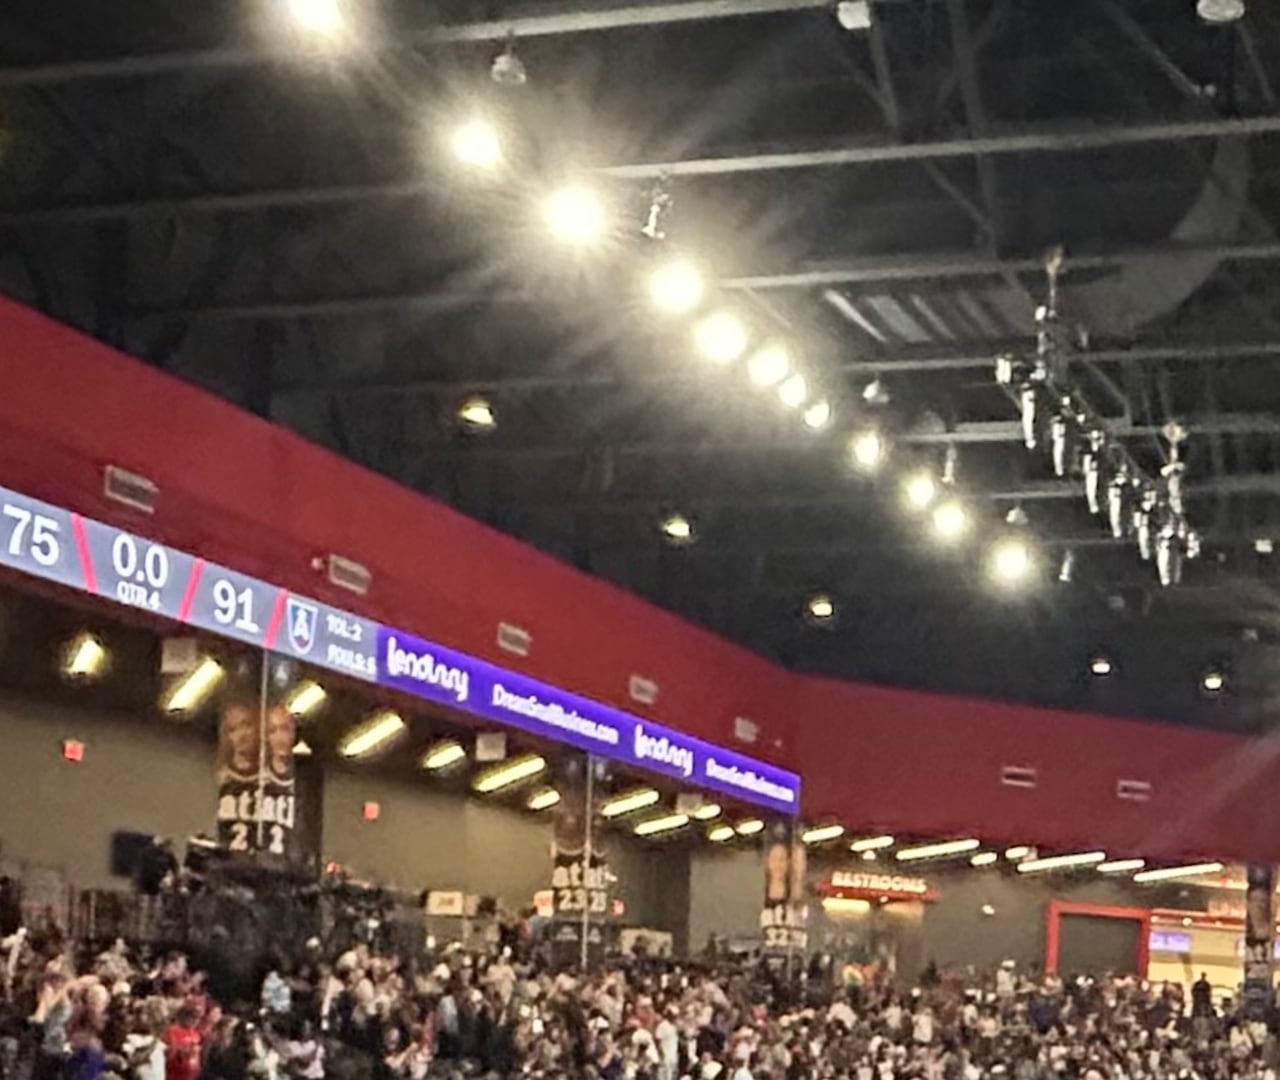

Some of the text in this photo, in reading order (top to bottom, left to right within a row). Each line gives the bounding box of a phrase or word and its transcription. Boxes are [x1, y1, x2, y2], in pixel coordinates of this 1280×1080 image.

[3, 503, 60, 566] 75
[112, 533, 169, 588] 0.0
[213, 580, 259, 633] 91
[831, 871, 927, 893] RESTROOMS
